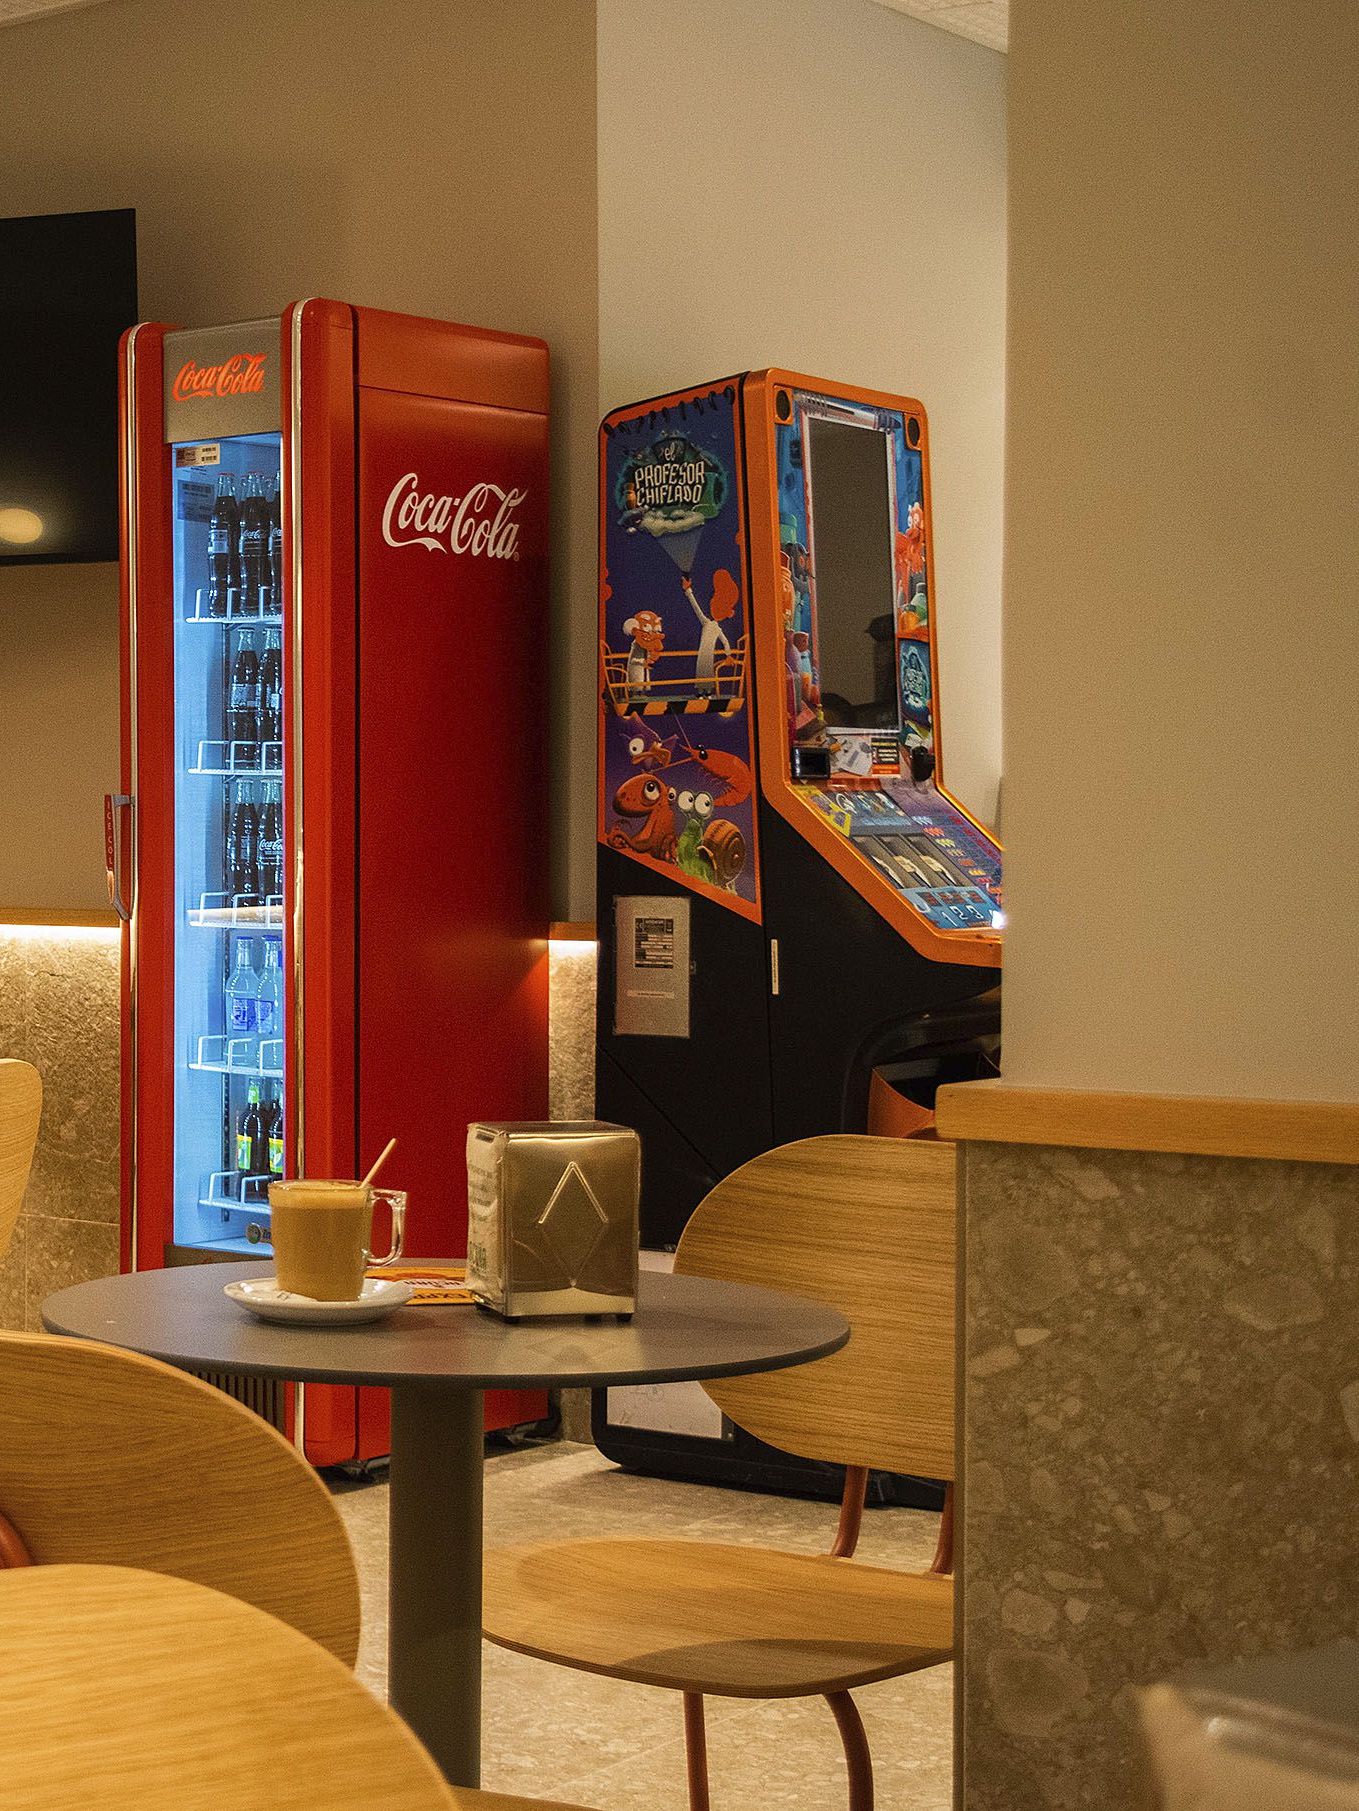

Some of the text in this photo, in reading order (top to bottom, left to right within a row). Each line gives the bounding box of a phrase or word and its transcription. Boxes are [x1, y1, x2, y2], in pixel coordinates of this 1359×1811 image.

[172, 353, 267, 402] Coca-Cola
[635, 460, 705, 489] PROFESOR
[637, 484, 702, 506] CHIFLADO
[382, 472, 528, 560] Coca-Cola
